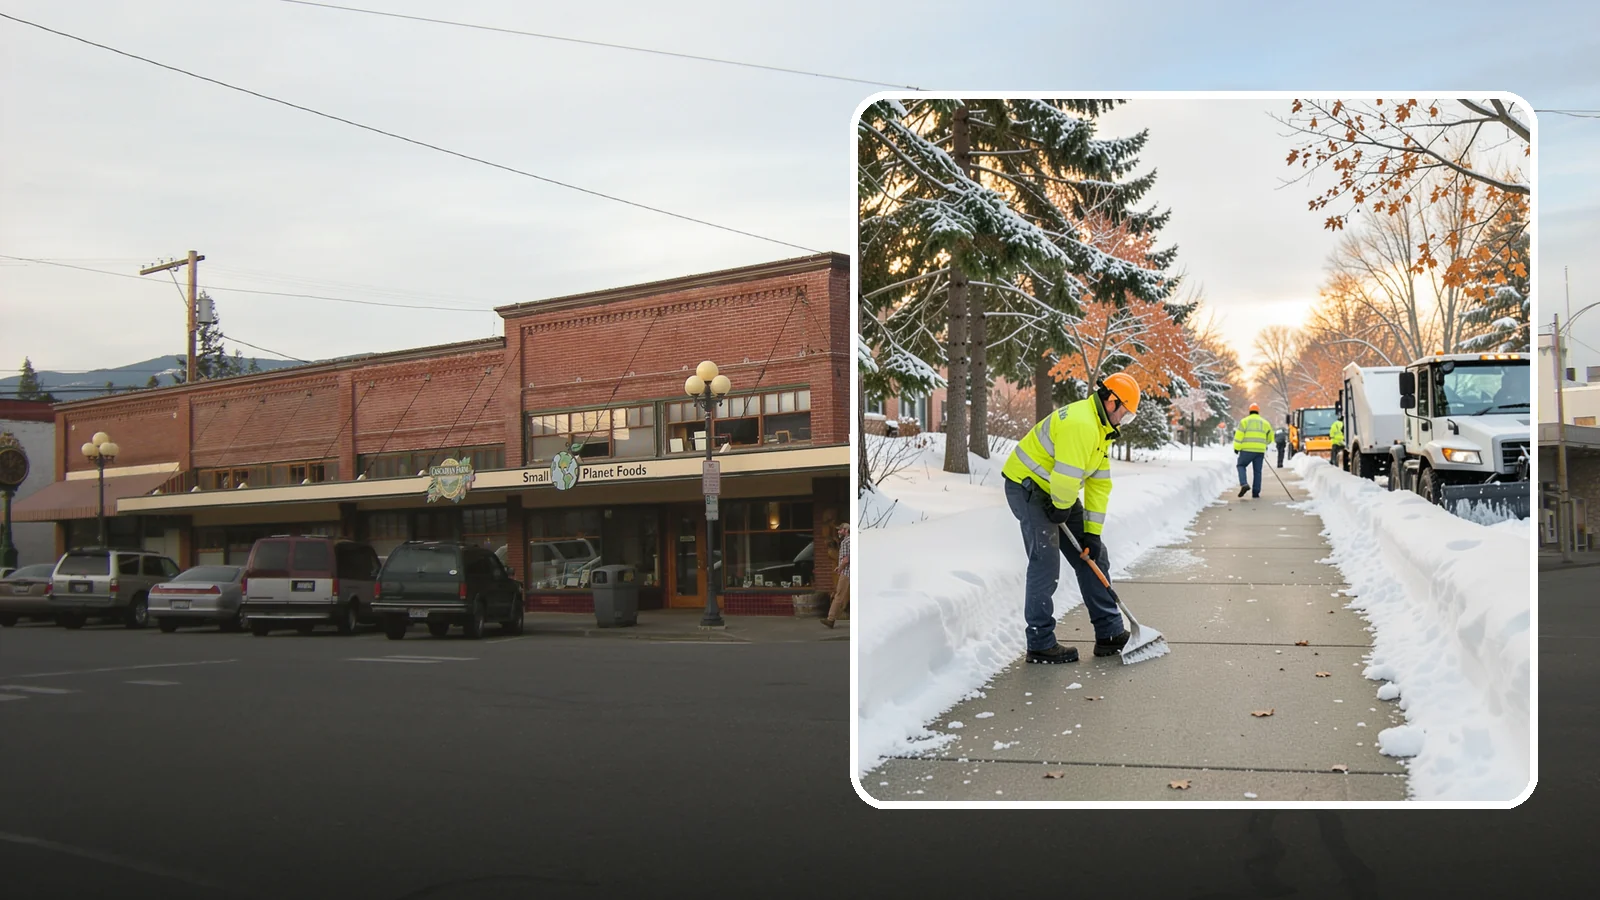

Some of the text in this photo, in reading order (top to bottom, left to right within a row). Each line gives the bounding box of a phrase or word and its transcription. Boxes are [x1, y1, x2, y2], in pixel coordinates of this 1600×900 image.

[522, 464, 647, 483] Small Planet Foods
